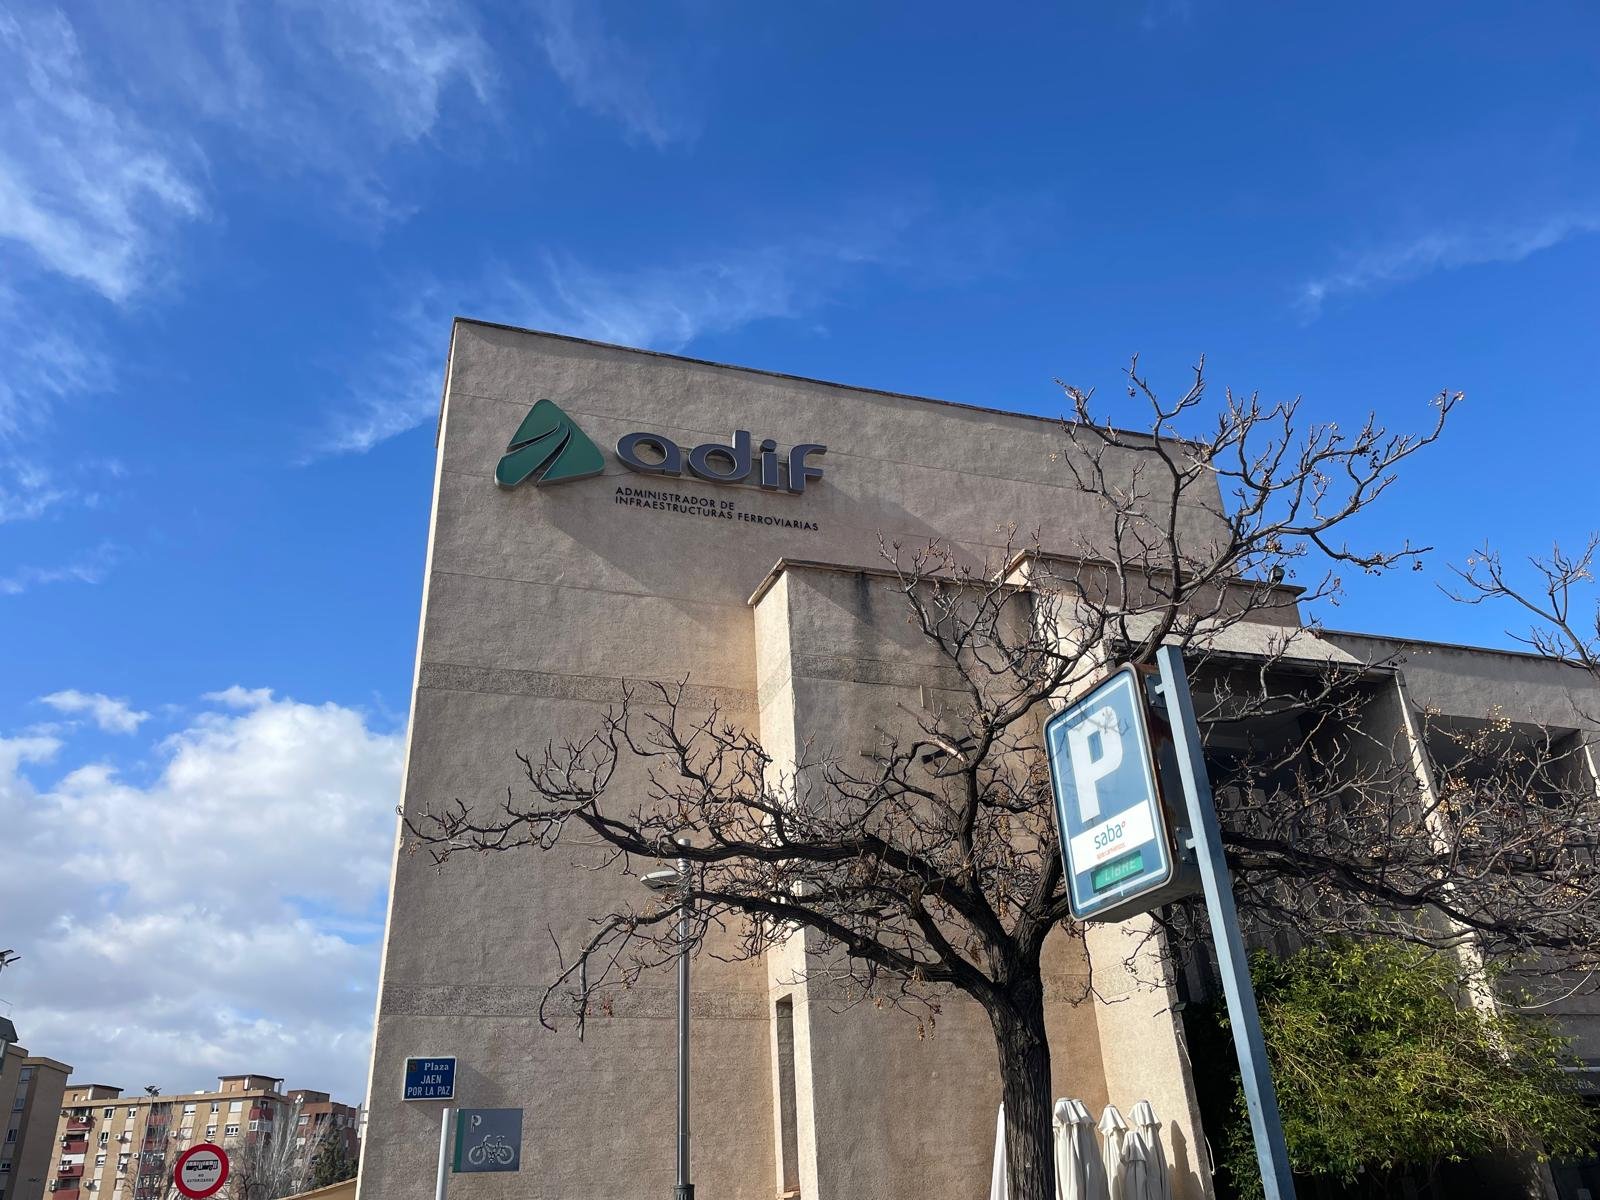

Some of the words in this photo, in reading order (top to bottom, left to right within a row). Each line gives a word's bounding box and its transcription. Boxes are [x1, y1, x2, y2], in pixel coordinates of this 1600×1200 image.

[615, 430, 827, 494] adif
[615, 487, 716, 509] ADMINISTRADOR
[720, 501, 735, 511] DE
[615, 496, 733, 521] INFRAESTRUCTURAS
[737, 512, 819, 532] FERROVIARIAS
[1067, 706, 1123, 824] P
[424, 1062, 449, 1071] Plaza
[407, 1087, 423, 1096] POR
[425, 1087, 434, 1096] LA
[437, 1086, 451, 1095] PAZ
[420, 1075, 442, 1084] JAEN
